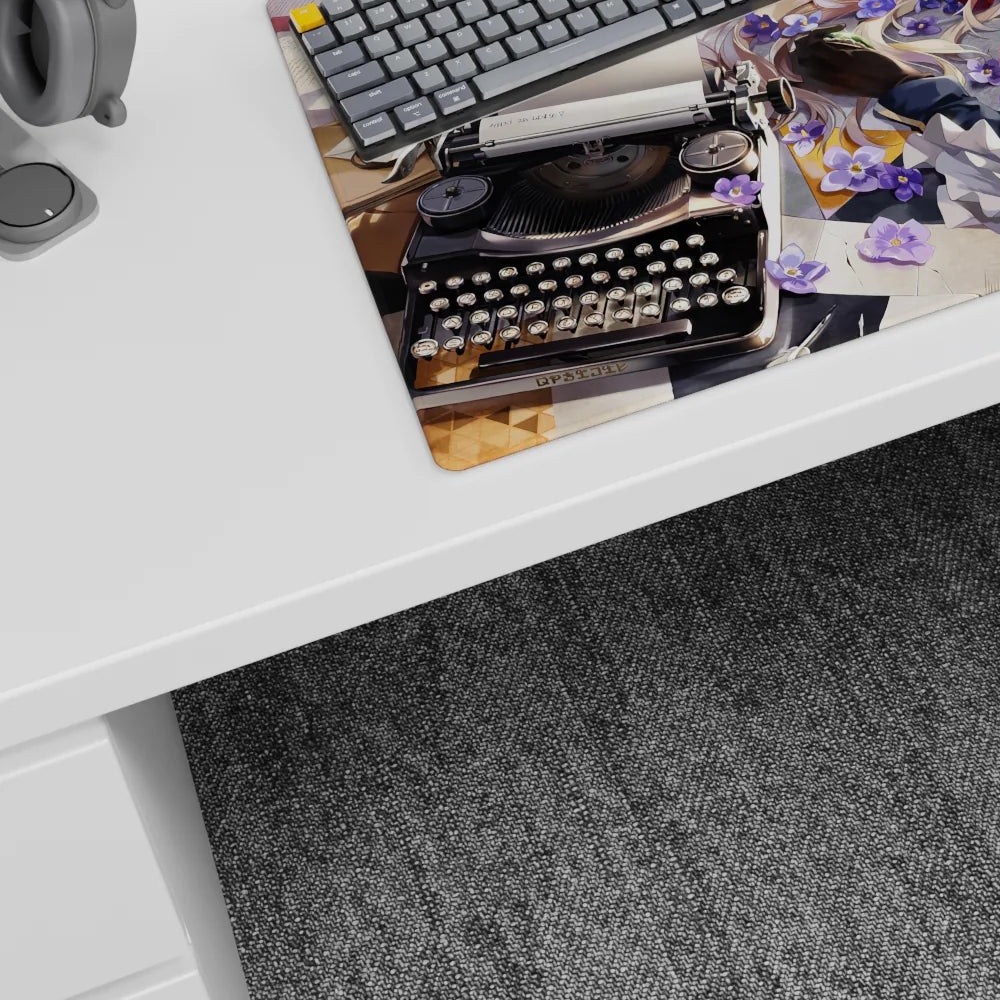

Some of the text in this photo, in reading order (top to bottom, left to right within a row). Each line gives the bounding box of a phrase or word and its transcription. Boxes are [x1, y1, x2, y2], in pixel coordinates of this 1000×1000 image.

[332, 49, 343, 57] tab
[347, 70, 361, 79] caps
[368, 89, 382, 98] shift
[438, 84, 466, 99] command
[403, 102, 422, 112] option
[362, 117, 383, 128] control
